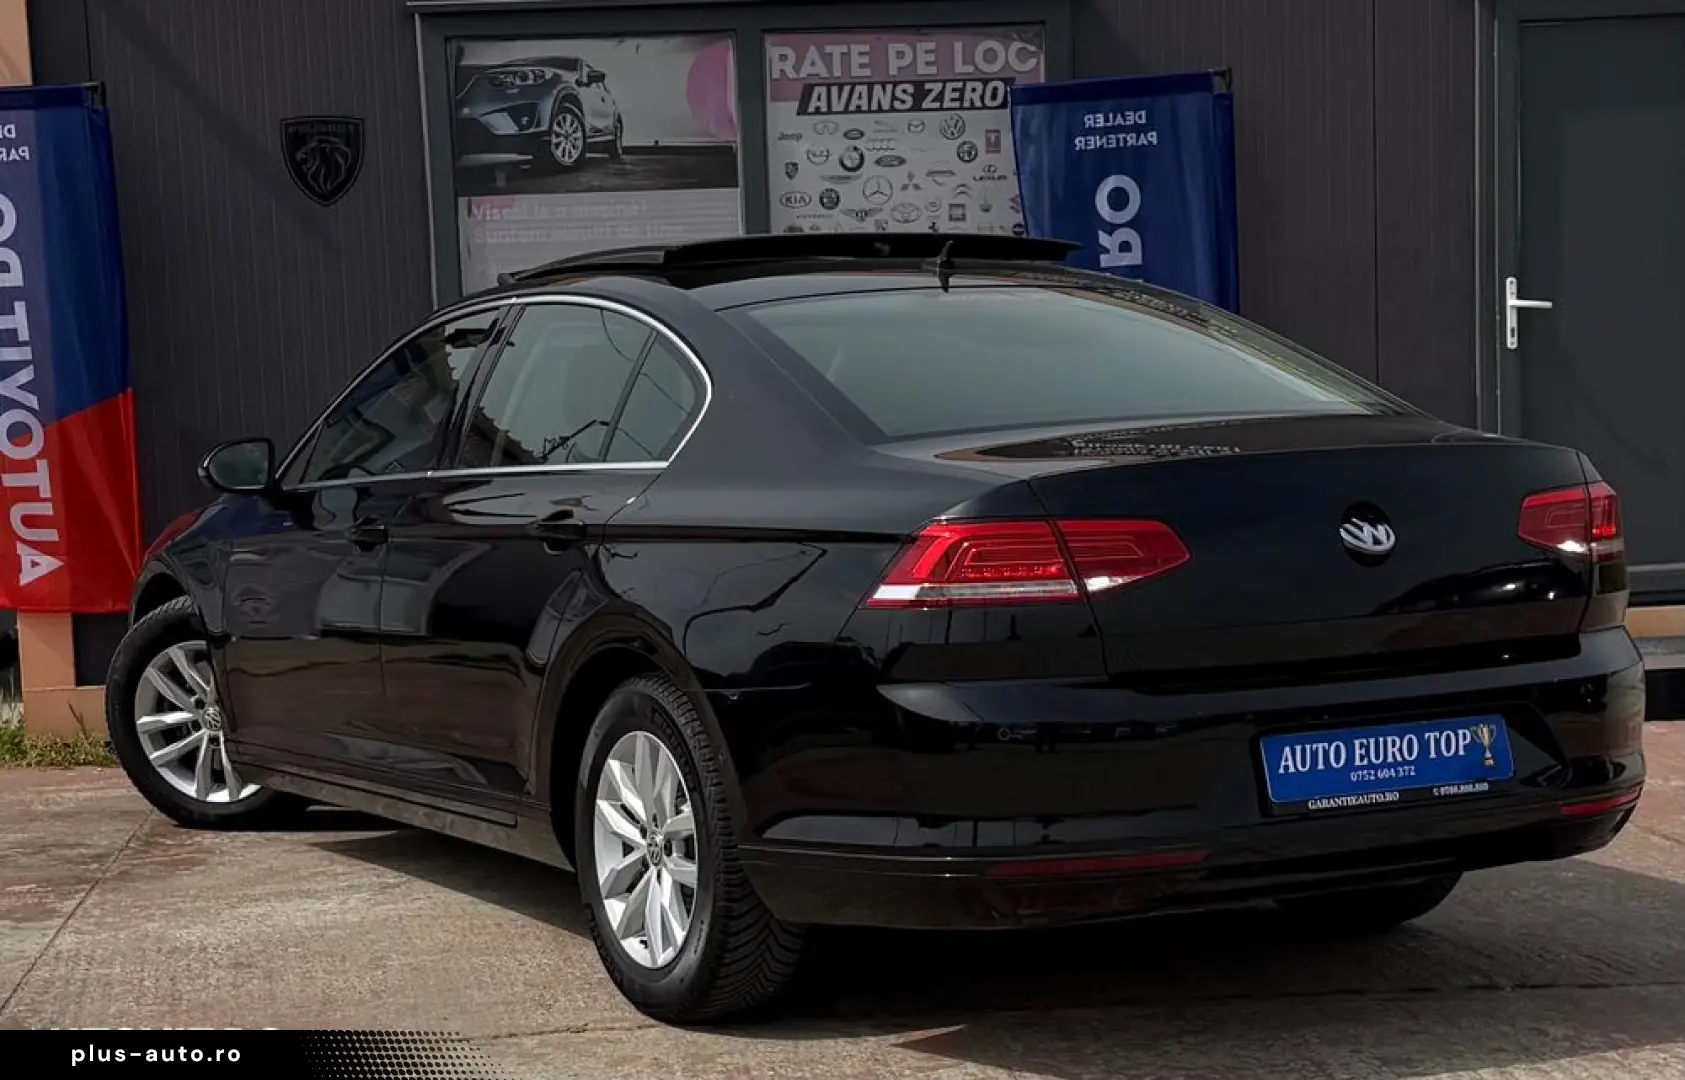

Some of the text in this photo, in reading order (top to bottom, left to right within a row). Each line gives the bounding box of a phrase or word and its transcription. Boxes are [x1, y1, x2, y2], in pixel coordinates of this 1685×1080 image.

[770, 39, 1038, 79] RATE PE LOC
[807, 80, 1007, 113] AVANS ZERO
[784, 195, 807, 205] KIA
[1278, 728, 1472, 774] AUTO EURO TOP
[1350, 770, 1376, 782] 0752
